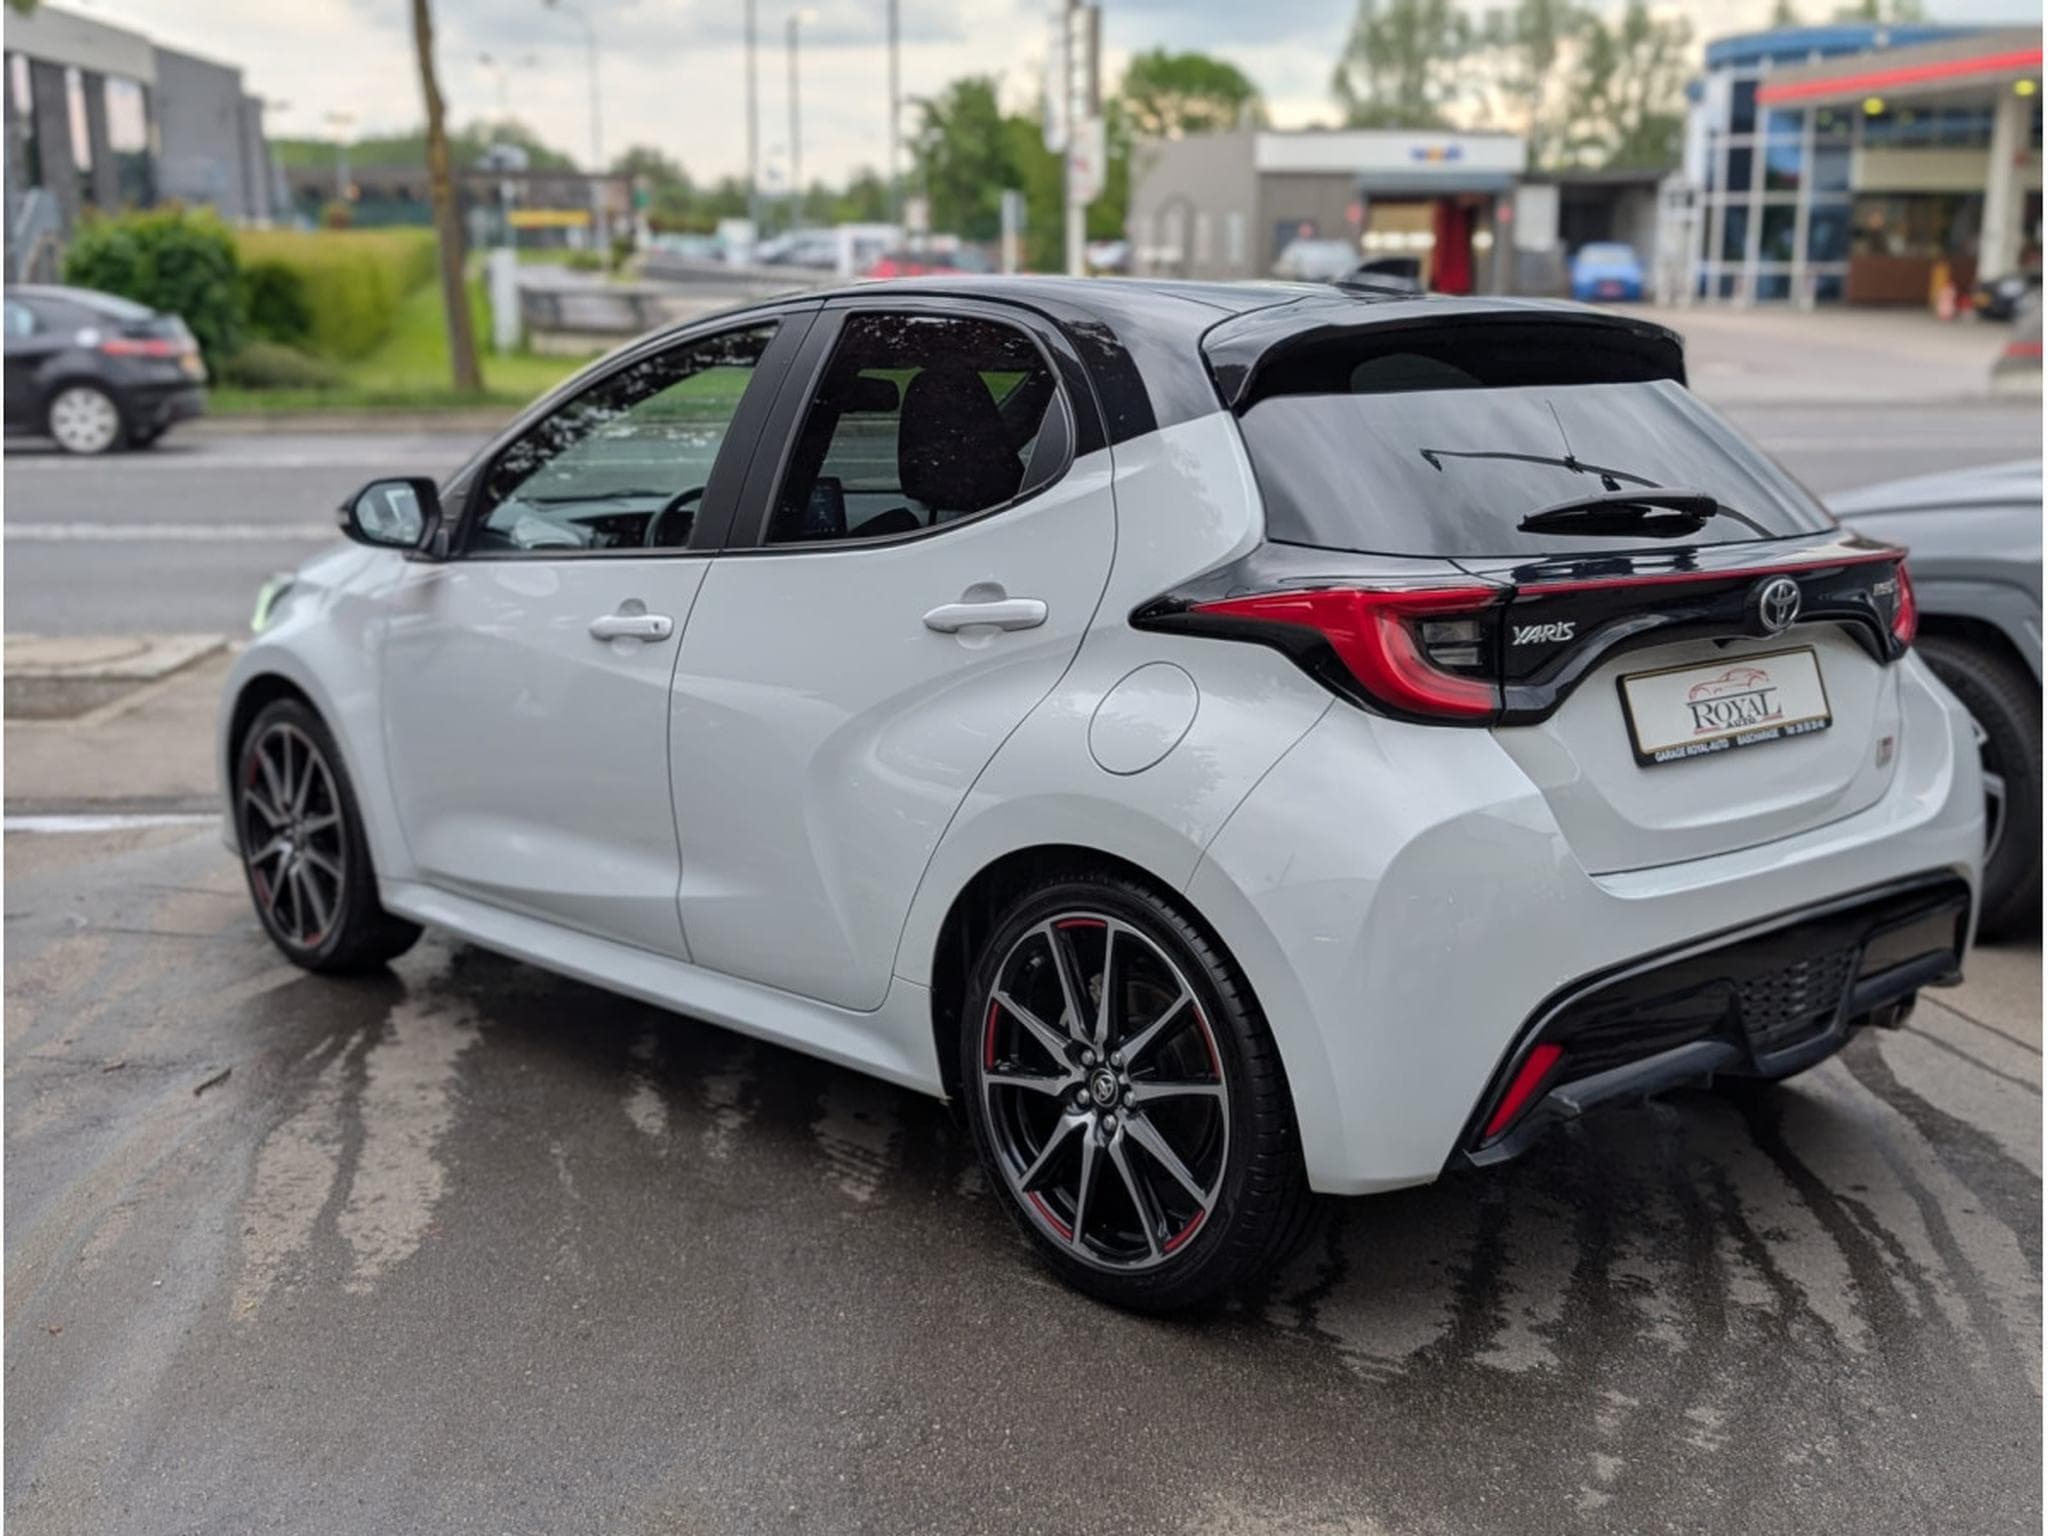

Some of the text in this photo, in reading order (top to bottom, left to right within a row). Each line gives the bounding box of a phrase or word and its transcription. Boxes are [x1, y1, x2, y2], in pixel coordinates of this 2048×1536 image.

[1511, 620, 1576, 645] YARIS
[1691, 693, 1783, 729] ROYAL
[1726, 714, 1757, 730] AUTO
